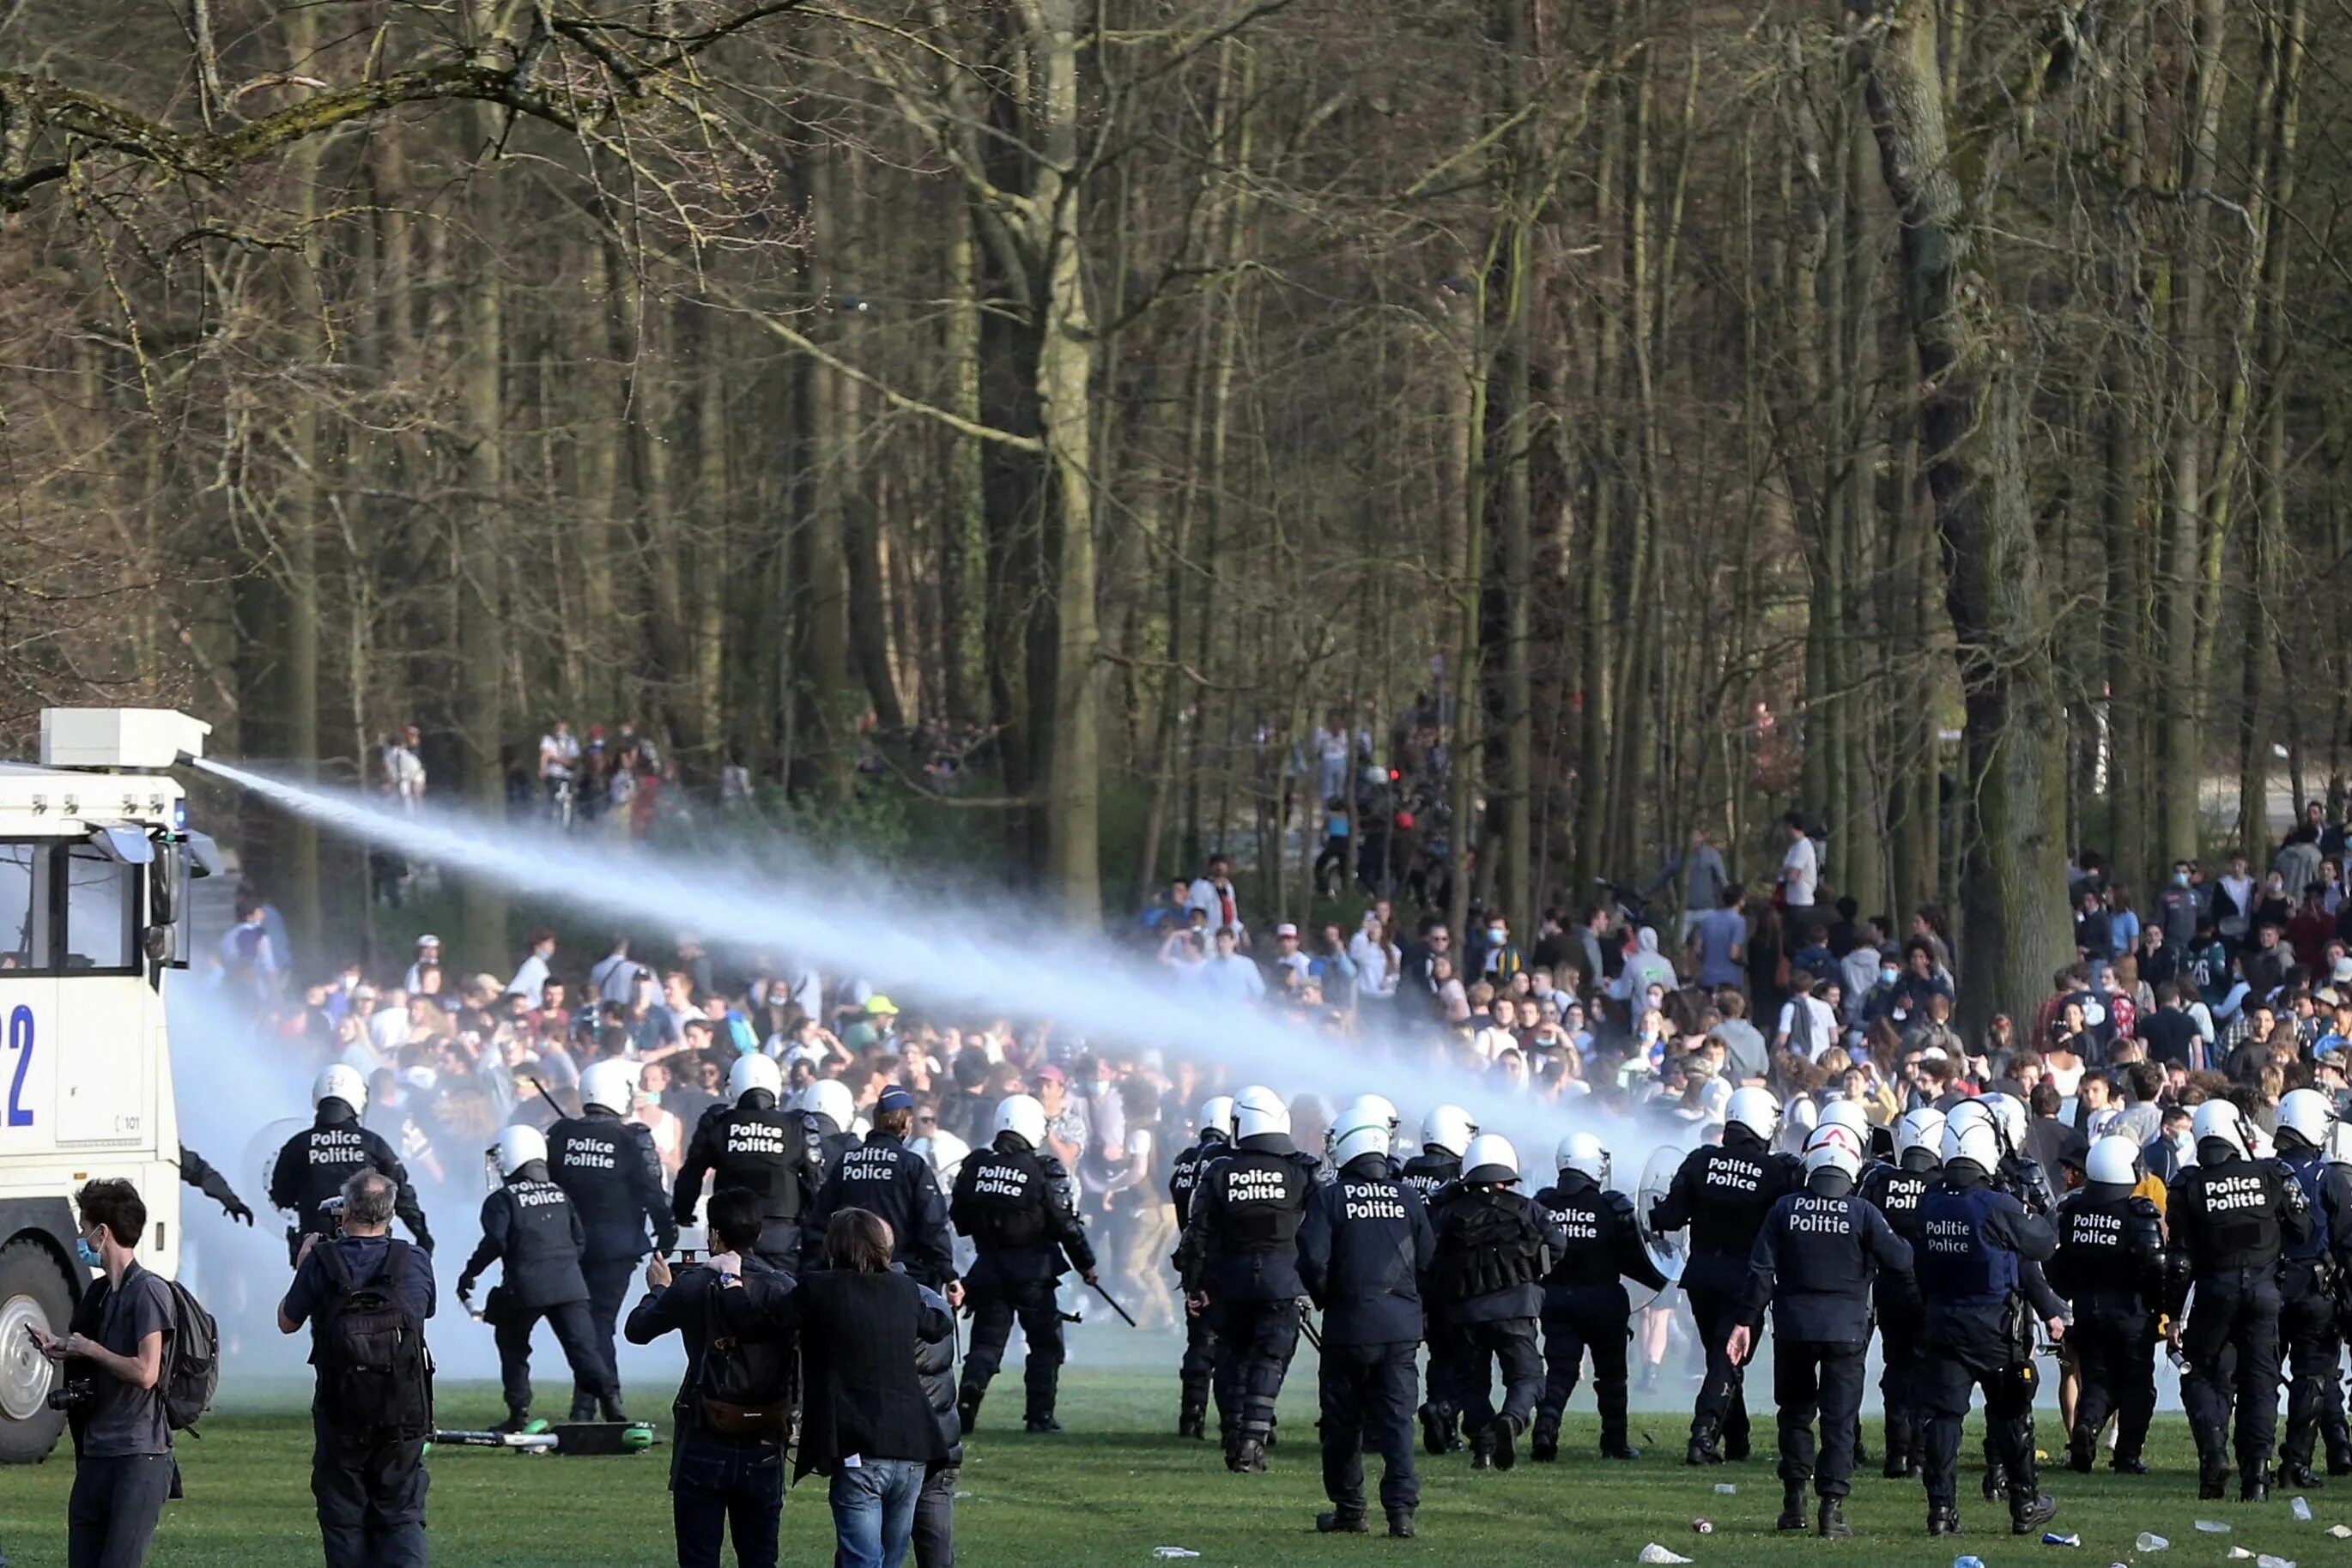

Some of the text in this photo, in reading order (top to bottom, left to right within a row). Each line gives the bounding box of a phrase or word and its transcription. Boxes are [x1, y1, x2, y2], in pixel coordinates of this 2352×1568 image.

[0, 1004, 34, 1126] 2
[124, 1117, 140, 1130] 101
[730, 1123, 783, 1138] Police
[311, 1130, 361, 1146] Police
[567, 1138, 615, 1153] Police
[728, 1138, 785, 1153] Politie
[309, 1147, 364, 1164] Politie
[564, 1153, 615, 1168] Politie
[844, 1147, 899, 1164] Politie
[843, 1164, 893, 1180] Police
[977, 1165, 1027, 1184] Politie
[1708, 1158, 1762, 1178] Politie
[1228, 1169, 1283, 1185] Police
[1706, 1172, 1757, 1191] Police
[975, 1180, 1022, 1197] Police
[1228, 1184, 1286, 1202] Politie
[1344, 1183, 1399, 1199] Police
[2205, 1177, 2261, 1196] Police
[518, 1190, 565, 1208] Police
[1794, 1196, 1848, 1213] Police
[2206, 1191, 2265, 1212] Politie
[1345, 1200, 1405, 1219] Politie
[1790, 1214, 1850, 1234] Politie
[1926, 1220, 1970, 1235] Politie
[2074, 1214, 2121, 1230] Politie
[1558, 1224, 1597, 1238] litie
[2072, 1230, 2118, 1245] Police
[1928, 1238, 1968, 1253] Police
